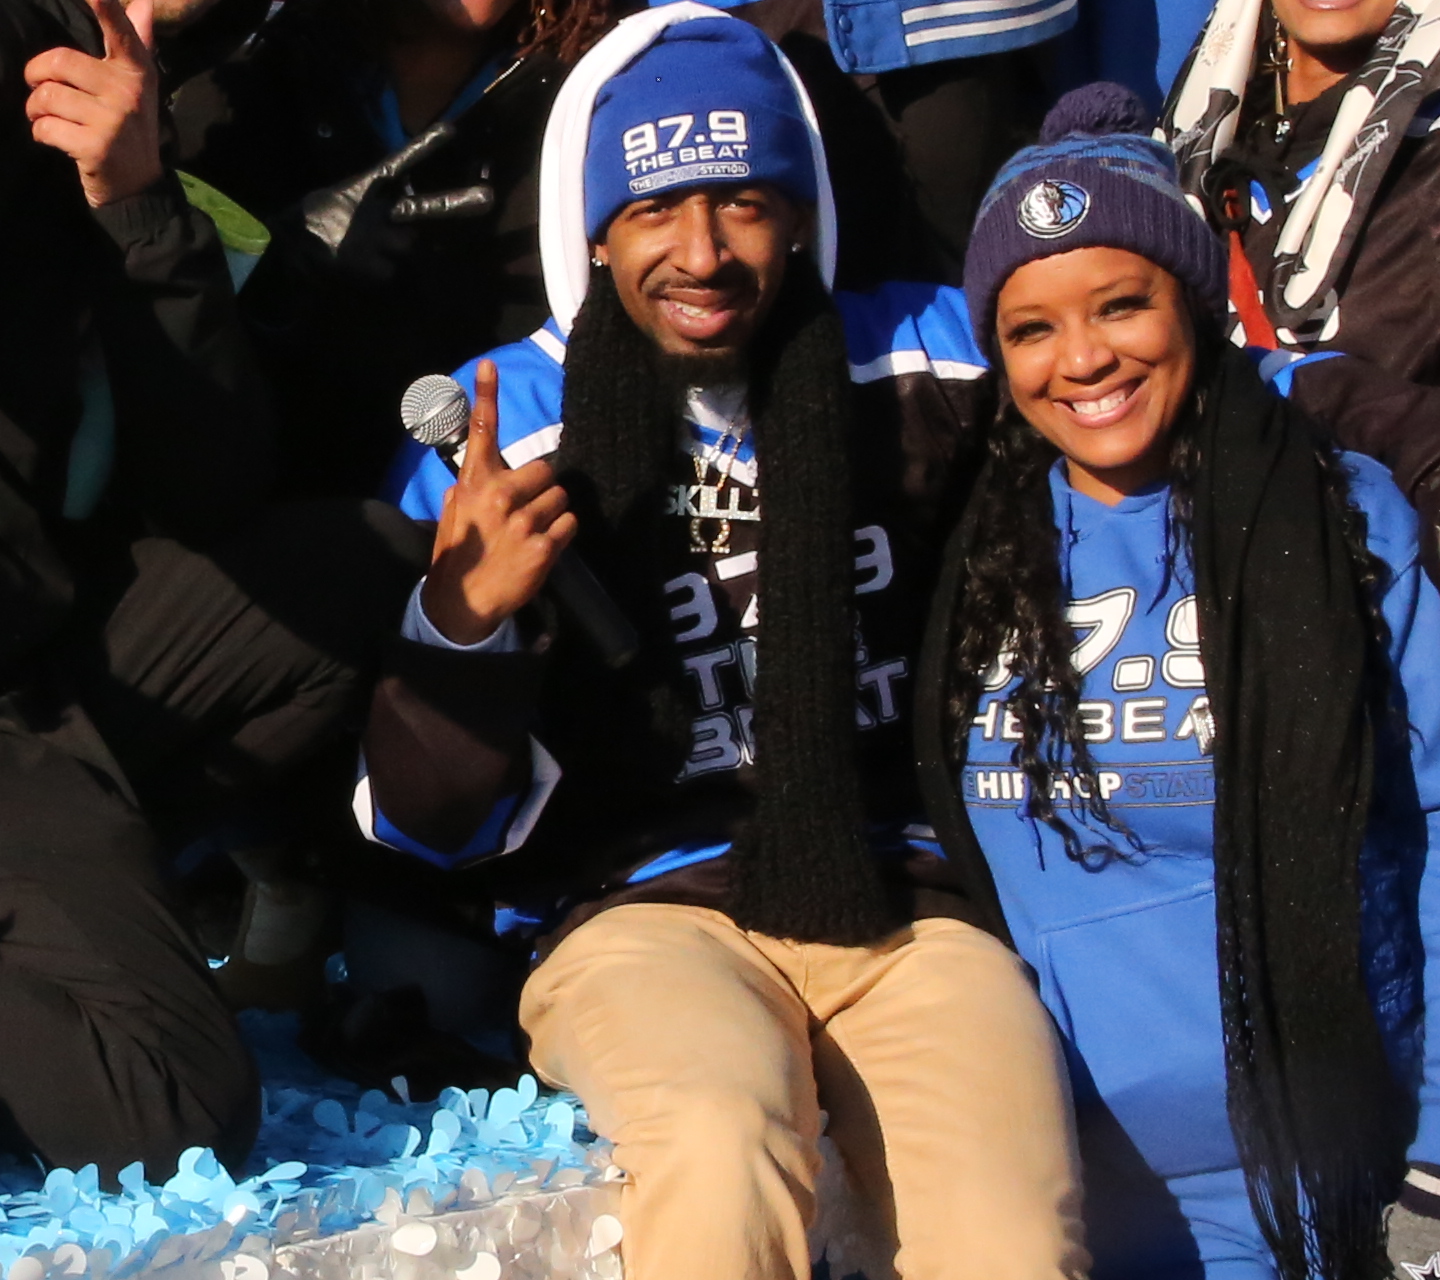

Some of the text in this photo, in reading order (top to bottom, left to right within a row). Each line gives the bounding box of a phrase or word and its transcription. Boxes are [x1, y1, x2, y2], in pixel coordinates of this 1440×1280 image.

[622, 109, 748, 163] 97.9
[625, 151, 676, 177] THE
[678, 144, 750, 164] BEAT
